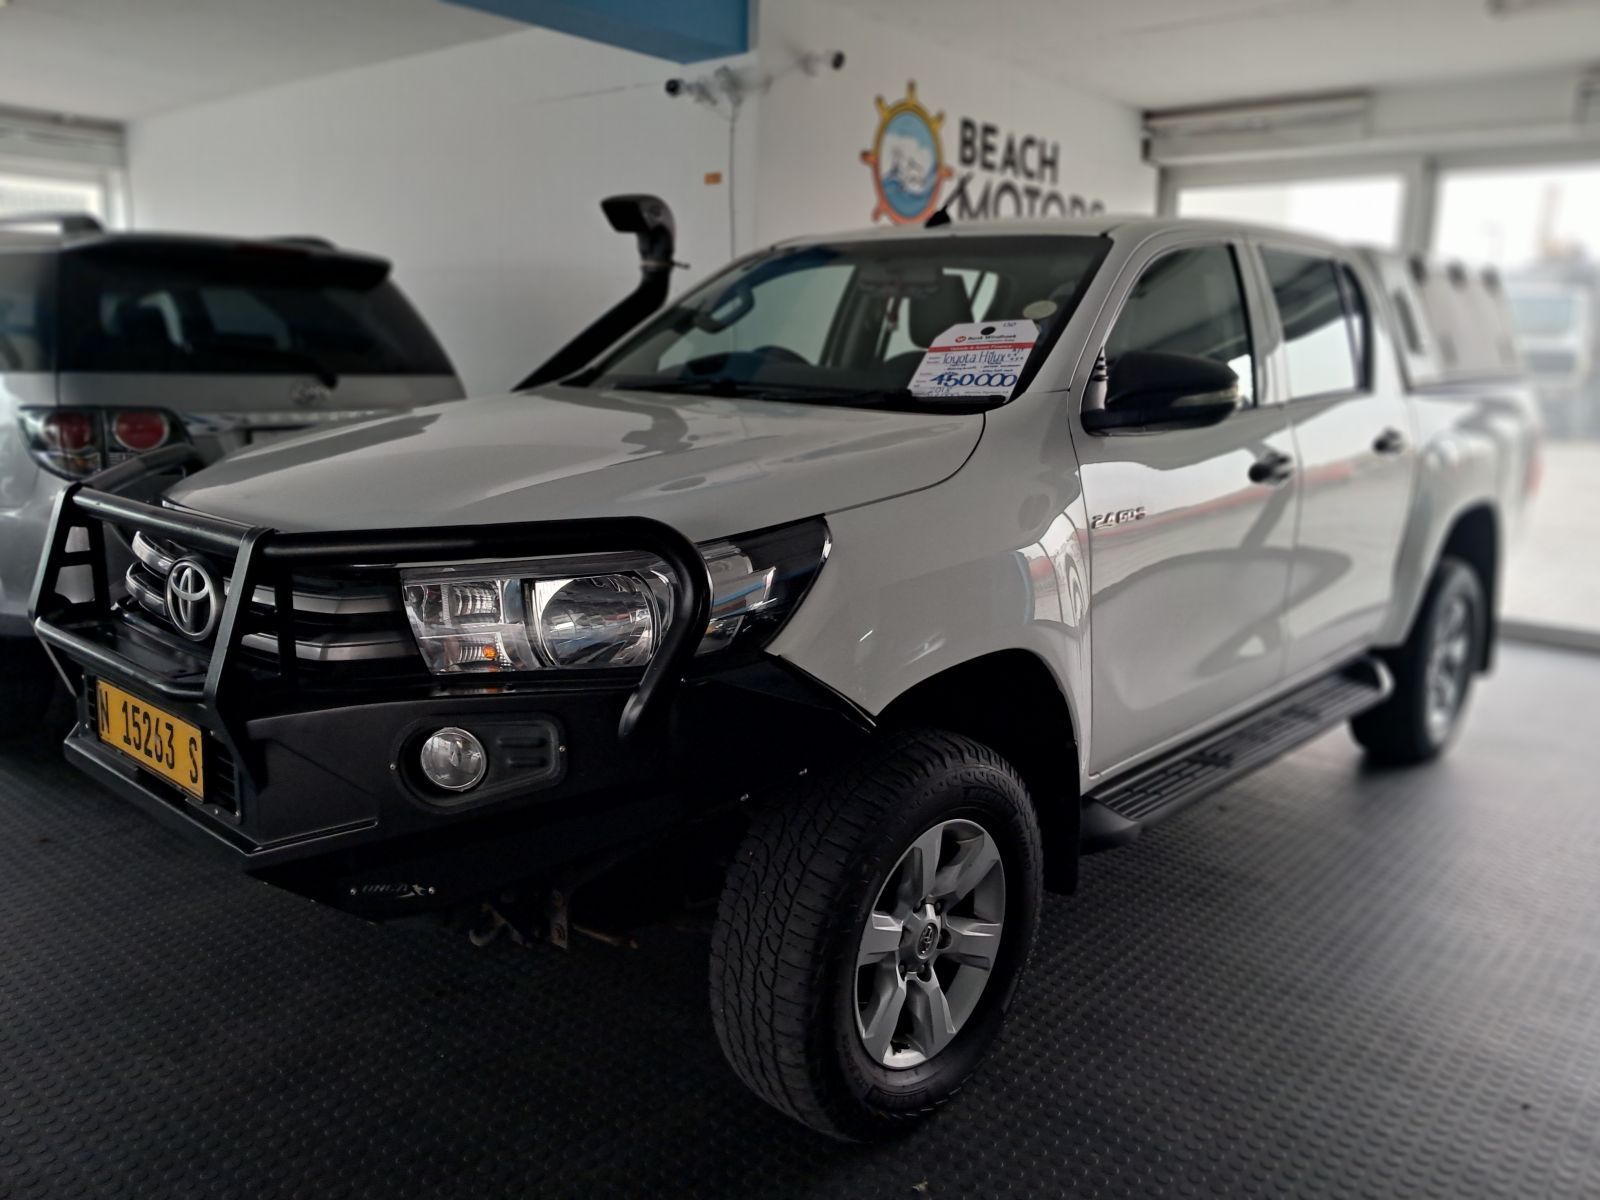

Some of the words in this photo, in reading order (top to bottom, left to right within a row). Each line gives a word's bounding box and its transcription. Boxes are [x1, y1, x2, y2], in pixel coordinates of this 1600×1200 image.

[960, 116, 1060, 186] BEACH
[943, 352, 976, 365] Toyota
[979, 351, 1006, 364] Hilux
[99, 688, 110, 734] N
[122, 700, 175, 770] 15263
[188, 736, 198, 784] S
